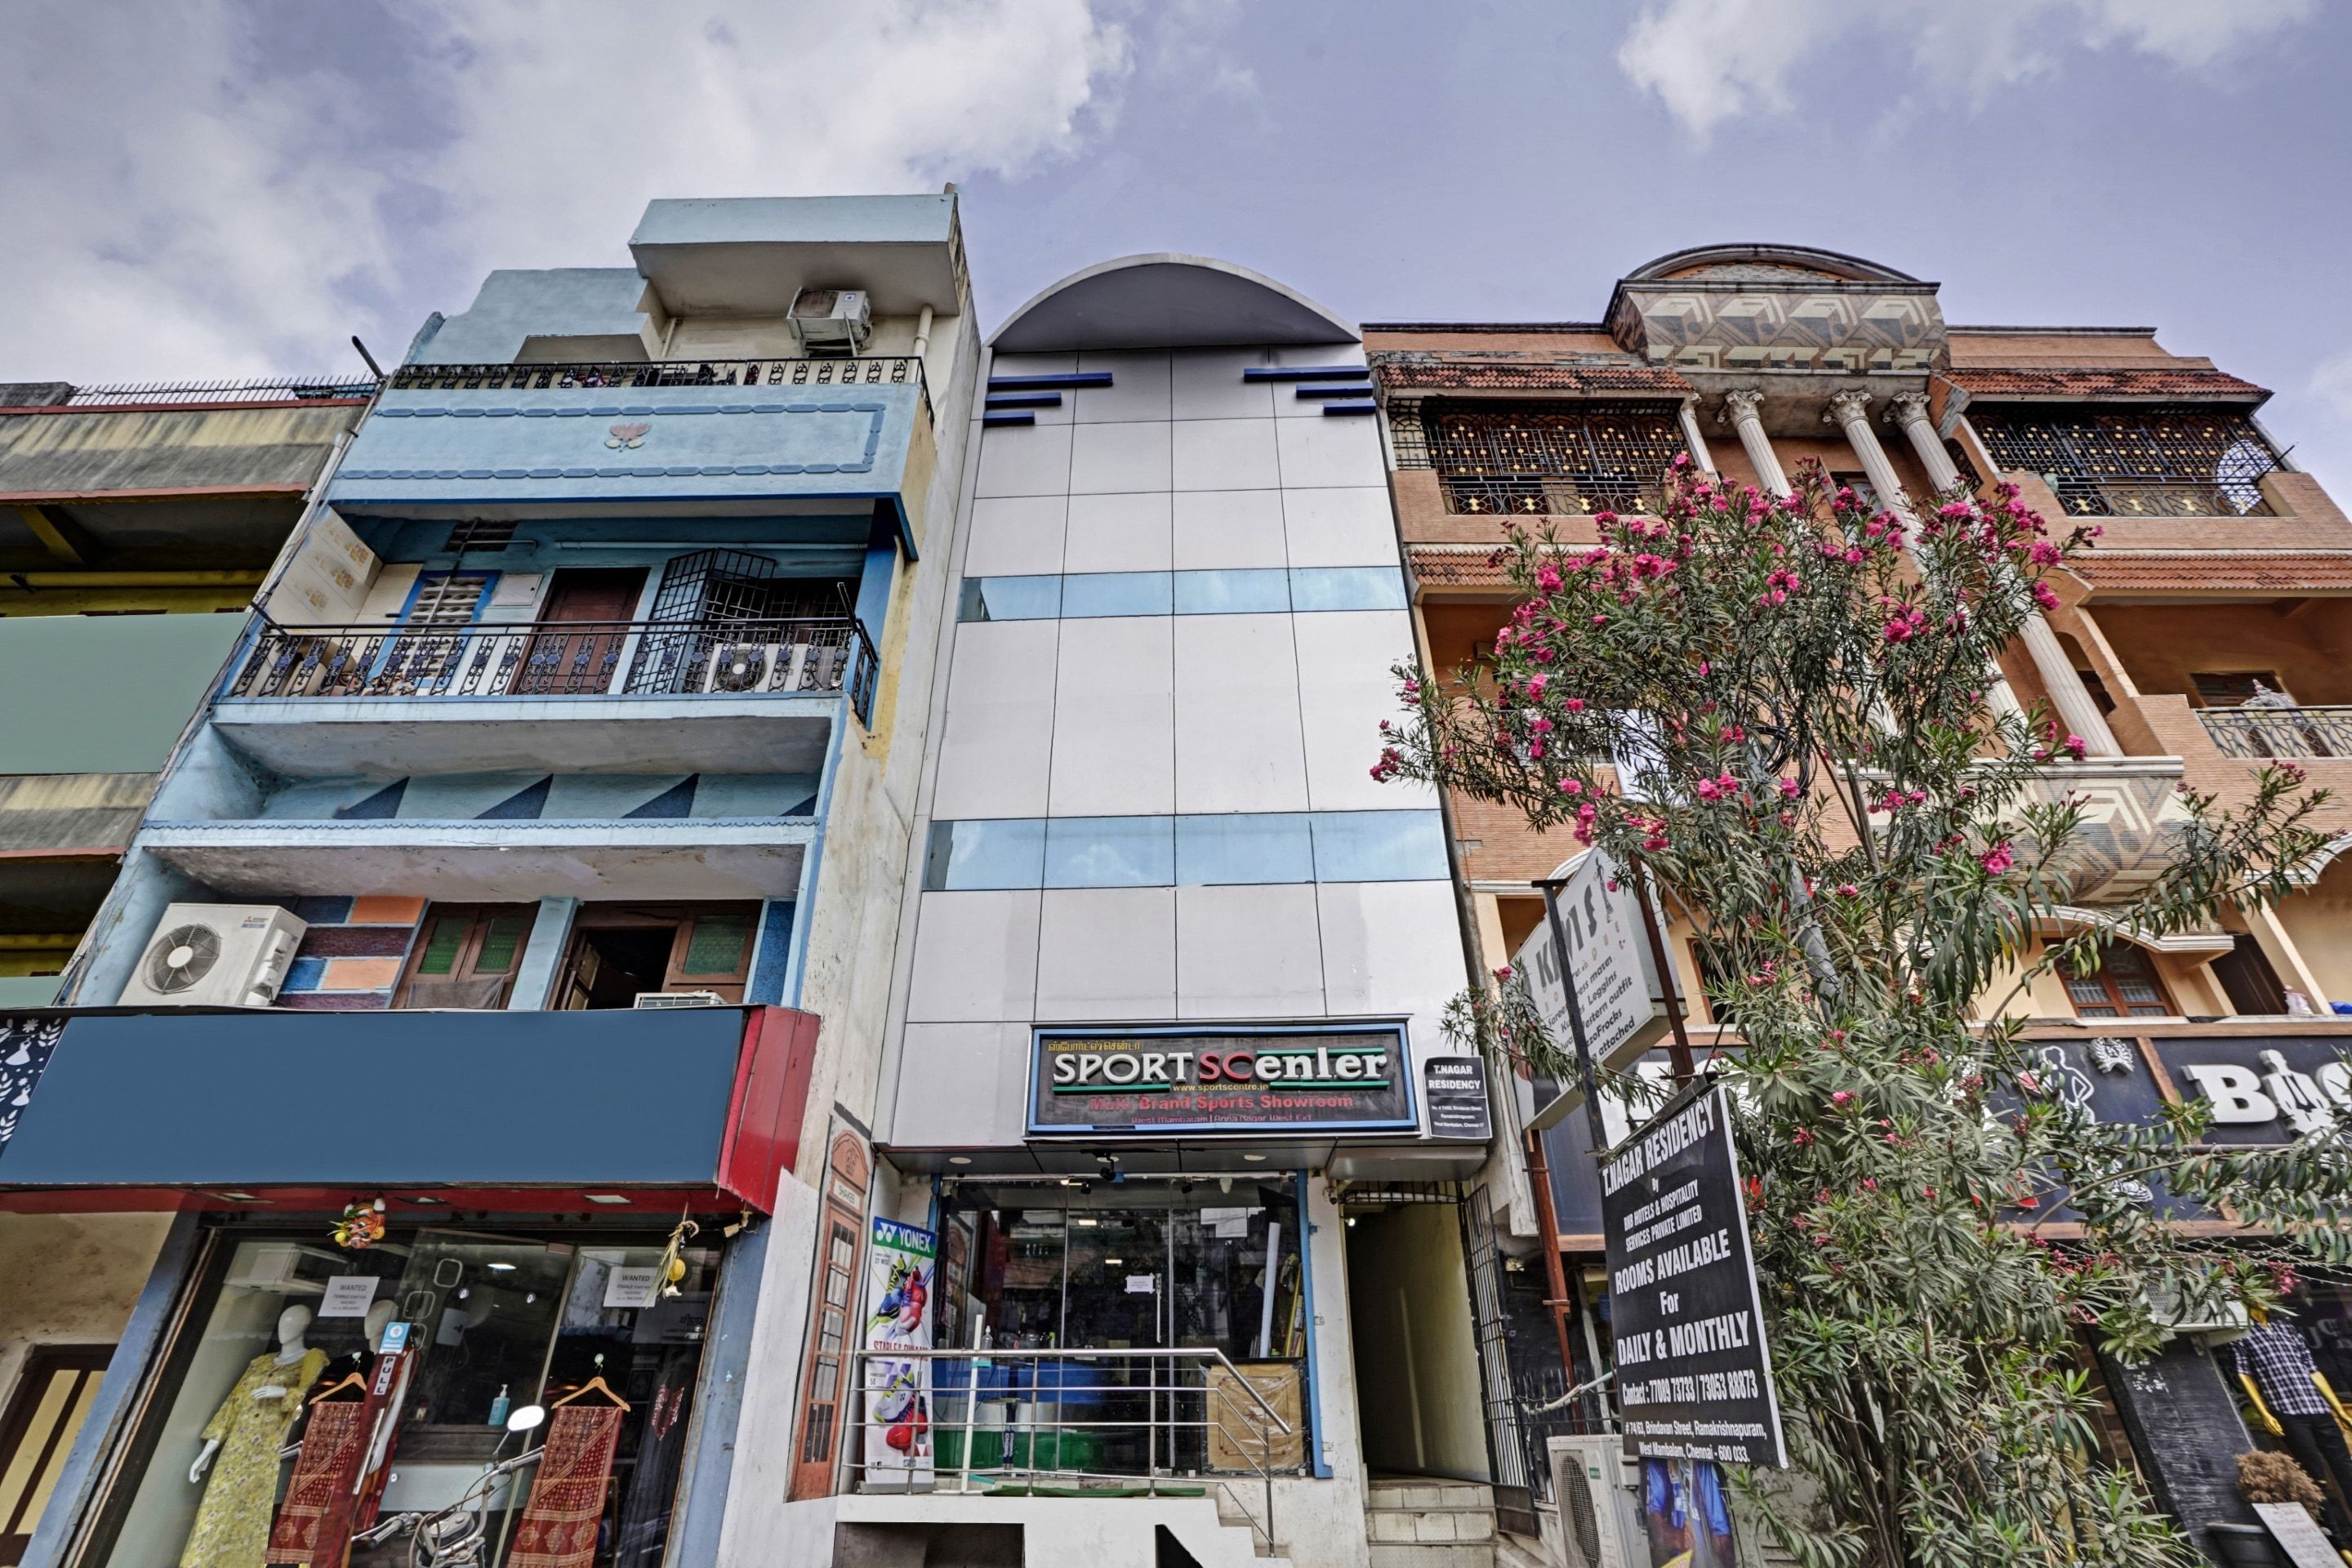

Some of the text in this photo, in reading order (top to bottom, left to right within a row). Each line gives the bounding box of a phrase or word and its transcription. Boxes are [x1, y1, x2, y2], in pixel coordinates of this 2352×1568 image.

[1582, 976, 1633, 1029] estern outfit
[1587, 970, 1618, 1006] Leggins
[1598, 1015, 1636, 1056] attached
[1428, 1079, 1481, 1089] RESIDENCY
[1433, 1065, 1473, 1075] T.NAGAR
[1138, 1095, 1192, 1110] Brand
[1196, 1095, 1255, 1111] Sports
[1260, 1094, 1354, 1108] Showroom
[1602, 1094, 1715, 1197] T.NAGAR RESIDENCY
[1651, 1177, 1659, 1192] By
[1634, 1202, 1655, 1226] HOTELS
[1655, 1200, 1661, 1216] &
[1660, 1178, 1699, 1214] HOSPITALITY
[898, 1226, 932, 1254] YONEX
[1626, 1205, 1703, 1253] SERVICES PRIVATE LIMITED
[1615, 1228, 1731, 1295] ROOMS AVAILABLE
[1659, 1290, 1679, 1316] For
[1617, 1311, 1750, 1365] DAILY & MONTHLY
[376, 1357, 394, 1393] PULL
[1671, 1375, 1695, 1402] 73733
[1699, 1372, 1727, 1401] 73053
[1727, 1369, 1759, 1401] 88873
[1646, 1420, 1674, 1435] Brindavan
[1673, 1419, 1695, 1438] Street,
[1694, 1420, 1767, 1441] Ramakrishnapuram,
[1638, 1441, 1653, 1456] West
[1652, 1441, 1686, 1460] Mambalam,
[1686, 1442, 1713, 1460] Chennai
[1717, 1445, 1732, 1462] 600
[1732, 1446, 1751, 1463] 033.
